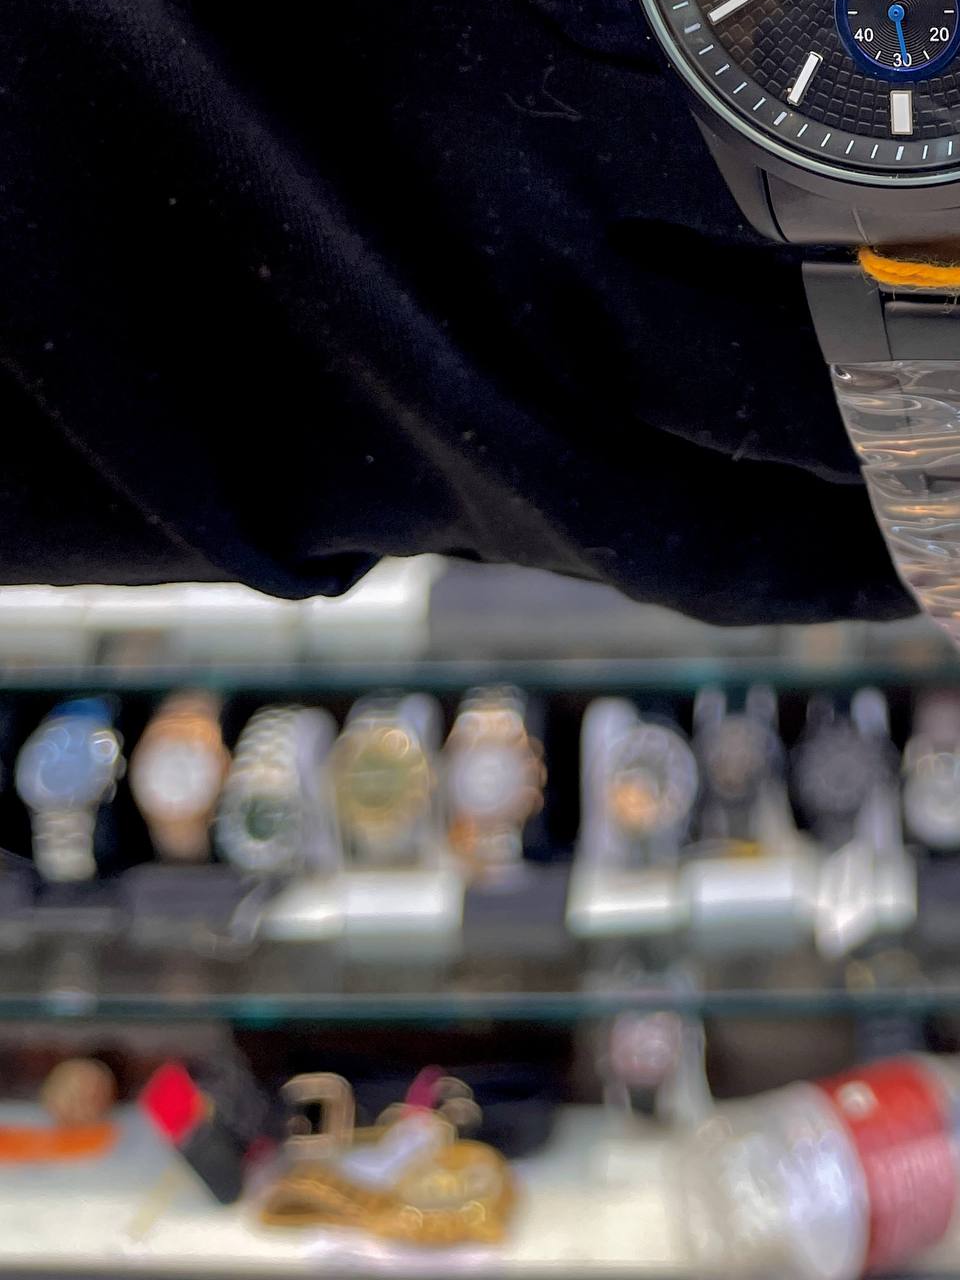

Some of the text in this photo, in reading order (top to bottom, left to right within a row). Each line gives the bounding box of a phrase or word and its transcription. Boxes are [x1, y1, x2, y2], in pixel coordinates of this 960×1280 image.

[854, 28, 874, 42] 40
[929, 27, 949, 42] 20
[892, 53, 912, 67] 30
